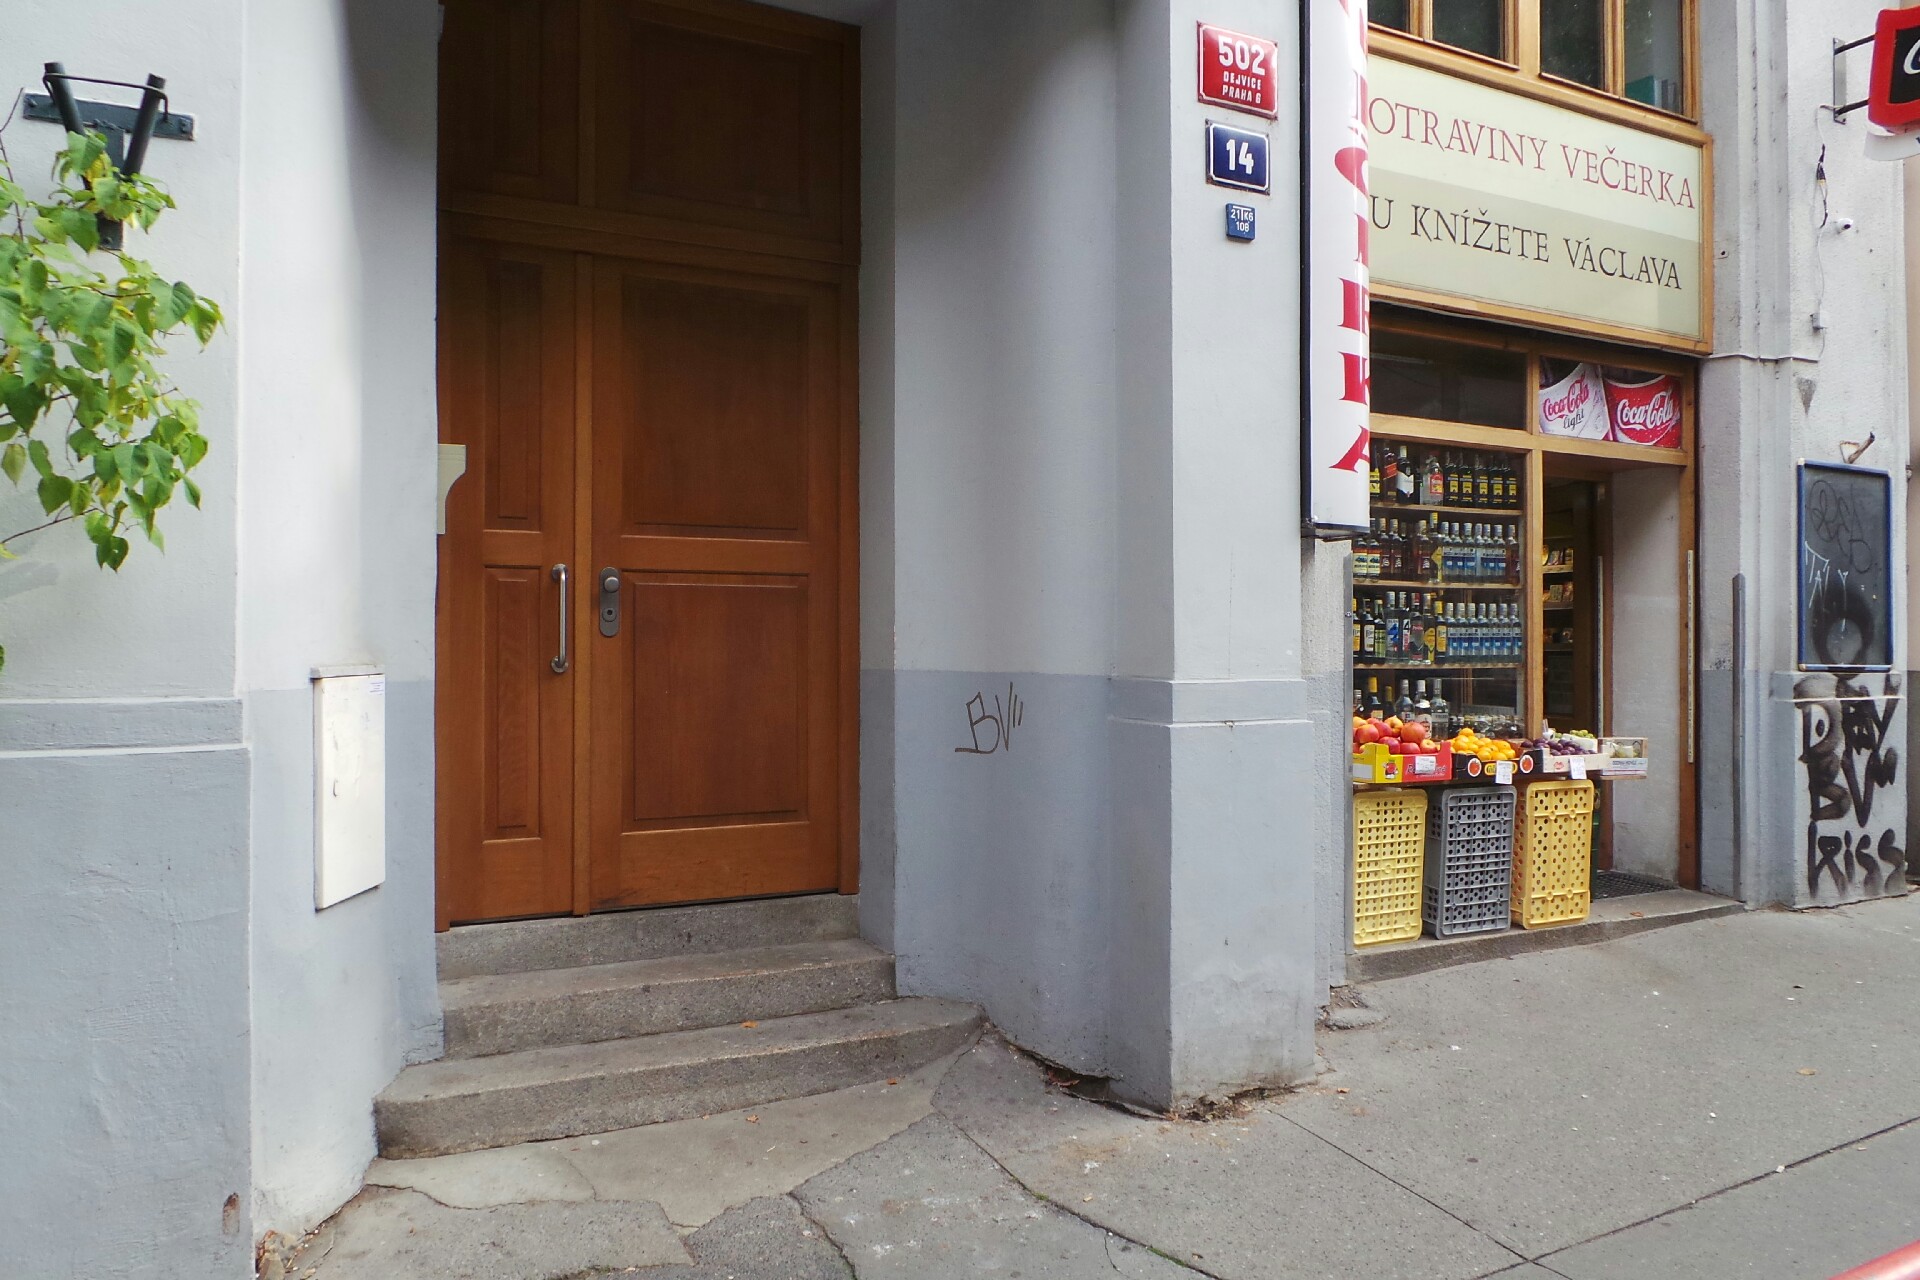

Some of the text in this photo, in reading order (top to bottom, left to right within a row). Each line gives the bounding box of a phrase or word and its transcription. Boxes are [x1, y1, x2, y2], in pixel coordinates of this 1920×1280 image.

[1218, 35, 1265, 76] 502
[1222, 84, 1262, 104] PRAHA 6
[1223, 71, 1262, 90] DEJVICE
[1226, 138, 1254, 175] 14
[1369, 97, 1696, 209] OTRAVINY VEČERKA
[1370, 194, 1682, 290] U KNÍŽETE VÁCLAVA
[1543, 371, 1590, 422] Coca-Cola
[1617, 388, 1675, 431] Coca-Cola
[1563, 408, 1585, 432] light
